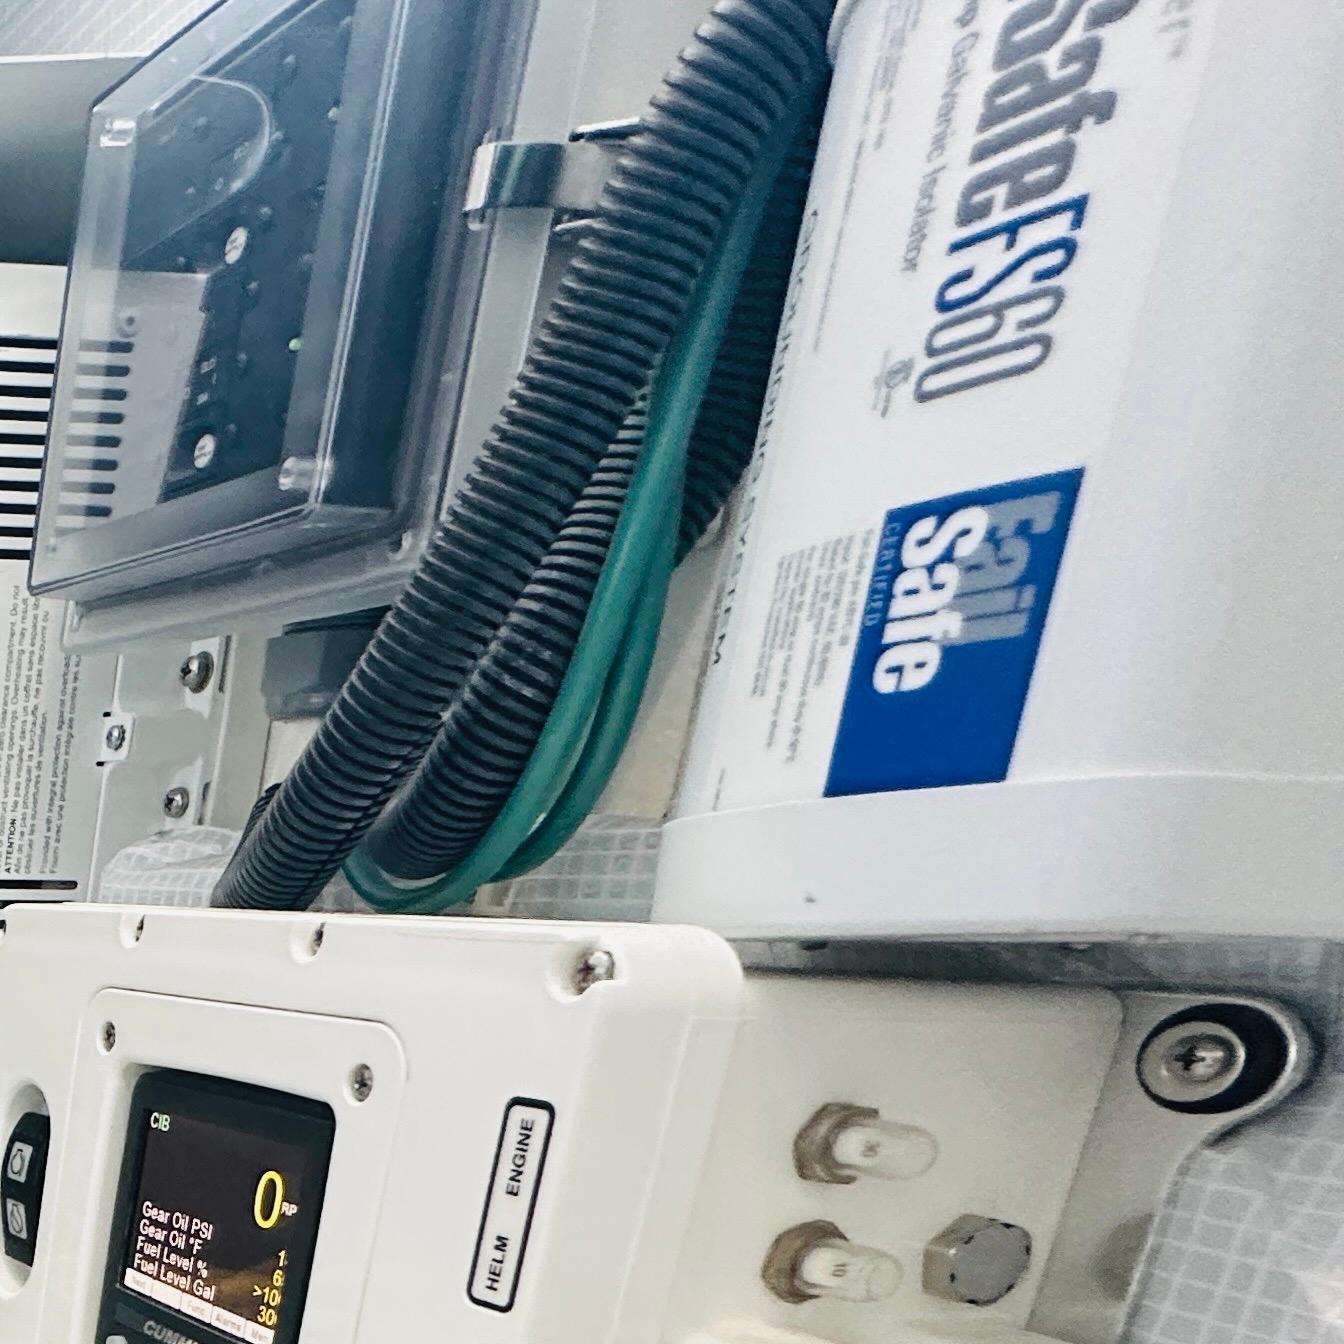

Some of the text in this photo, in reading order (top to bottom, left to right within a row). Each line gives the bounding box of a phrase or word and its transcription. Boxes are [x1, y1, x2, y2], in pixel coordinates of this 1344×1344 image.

[863, 522, 902, 627] CERTIFIED
[872, 506, 989, 694] Safe
[150, 1112, 171, 1132] CIB
[142, 1200, 169, 1225] Gear
[173, 1211, 189, 1229] Oil
[192, 1219, 213, 1241] PSI
[254, 1170, 285, 1229] 0
[485, 1118, 534, 1292] HELM ENGINE
[136, 1236, 160, 1258] Fuel
[163, 1247, 194, 1273] Level
[197, 1261, 208, 1278] %
[139, 1219, 166, 1243] Gear
[169, 1230, 186, 1250] Oil
[134, 1253, 157, 1276] Fuel
[160, 1265, 190, 1292] Level
[193, 1278, 216, 1302] Gal
